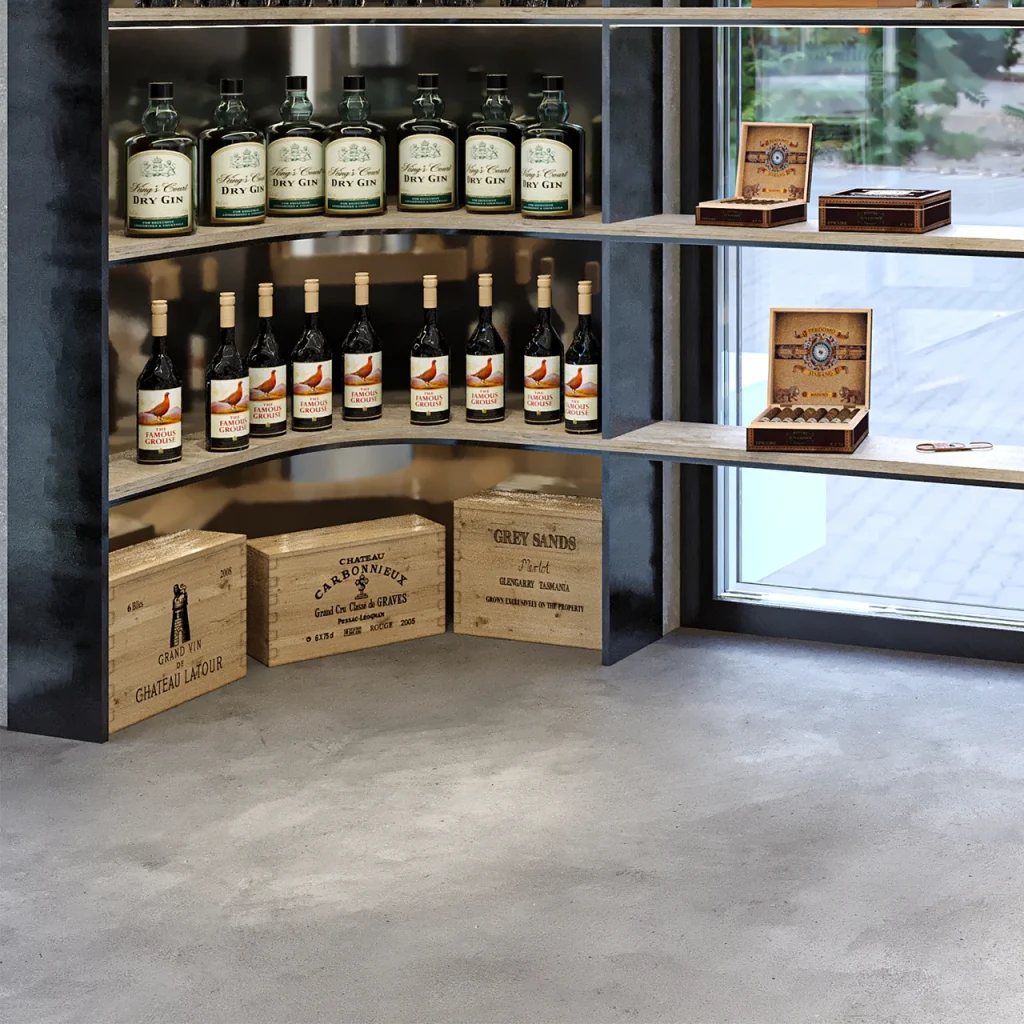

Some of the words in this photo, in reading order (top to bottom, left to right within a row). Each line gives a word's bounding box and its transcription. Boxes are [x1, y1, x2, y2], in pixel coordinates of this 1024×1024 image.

[270, 167, 296, 177] King's
[300, 167, 323, 176] Court
[328, 167, 355, 177] King's
[359, 167, 380, 176] Court
[401, 163, 427, 173] King's
[428, 163, 452, 172] Court
[486, 165, 511, 174] Court
[543, 169, 568, 178] Court
[216, 174, 248, 184] King's
[523, 180, 539, 188] DRY
[131, 183, 159, 195] King's
[164, 183, 188, 192] Court
[133, 196, 158, 204] DRY
[494, 529, 529, 546] GREY
[533, 533, 576, 551] SANDS
[339, 553, 385, 565] CHATEAU
[518, 558, 550, 574] Merlot
[314, 564, 408, 600] CARBONNIEUX
[500, 577, 535, 588] GLENGARRY
[540, 581, 570, 592] TASMANIA
[315, 607, 334, 618] Grand
[335, 605, 346, 614] Cru
[368, 599, 376, 608] de
[377, 593, 407, 607] GRAVES
[558, 603, 584, 613] PROPERTY
[370, 622, 393, 631] ROUGE
[158, 646, 186, 665] GRAND
[188, 639, 202, 654] VIN
[177, 660, 184, 669] DE
[185, 655, 223, 683] LATOUR
